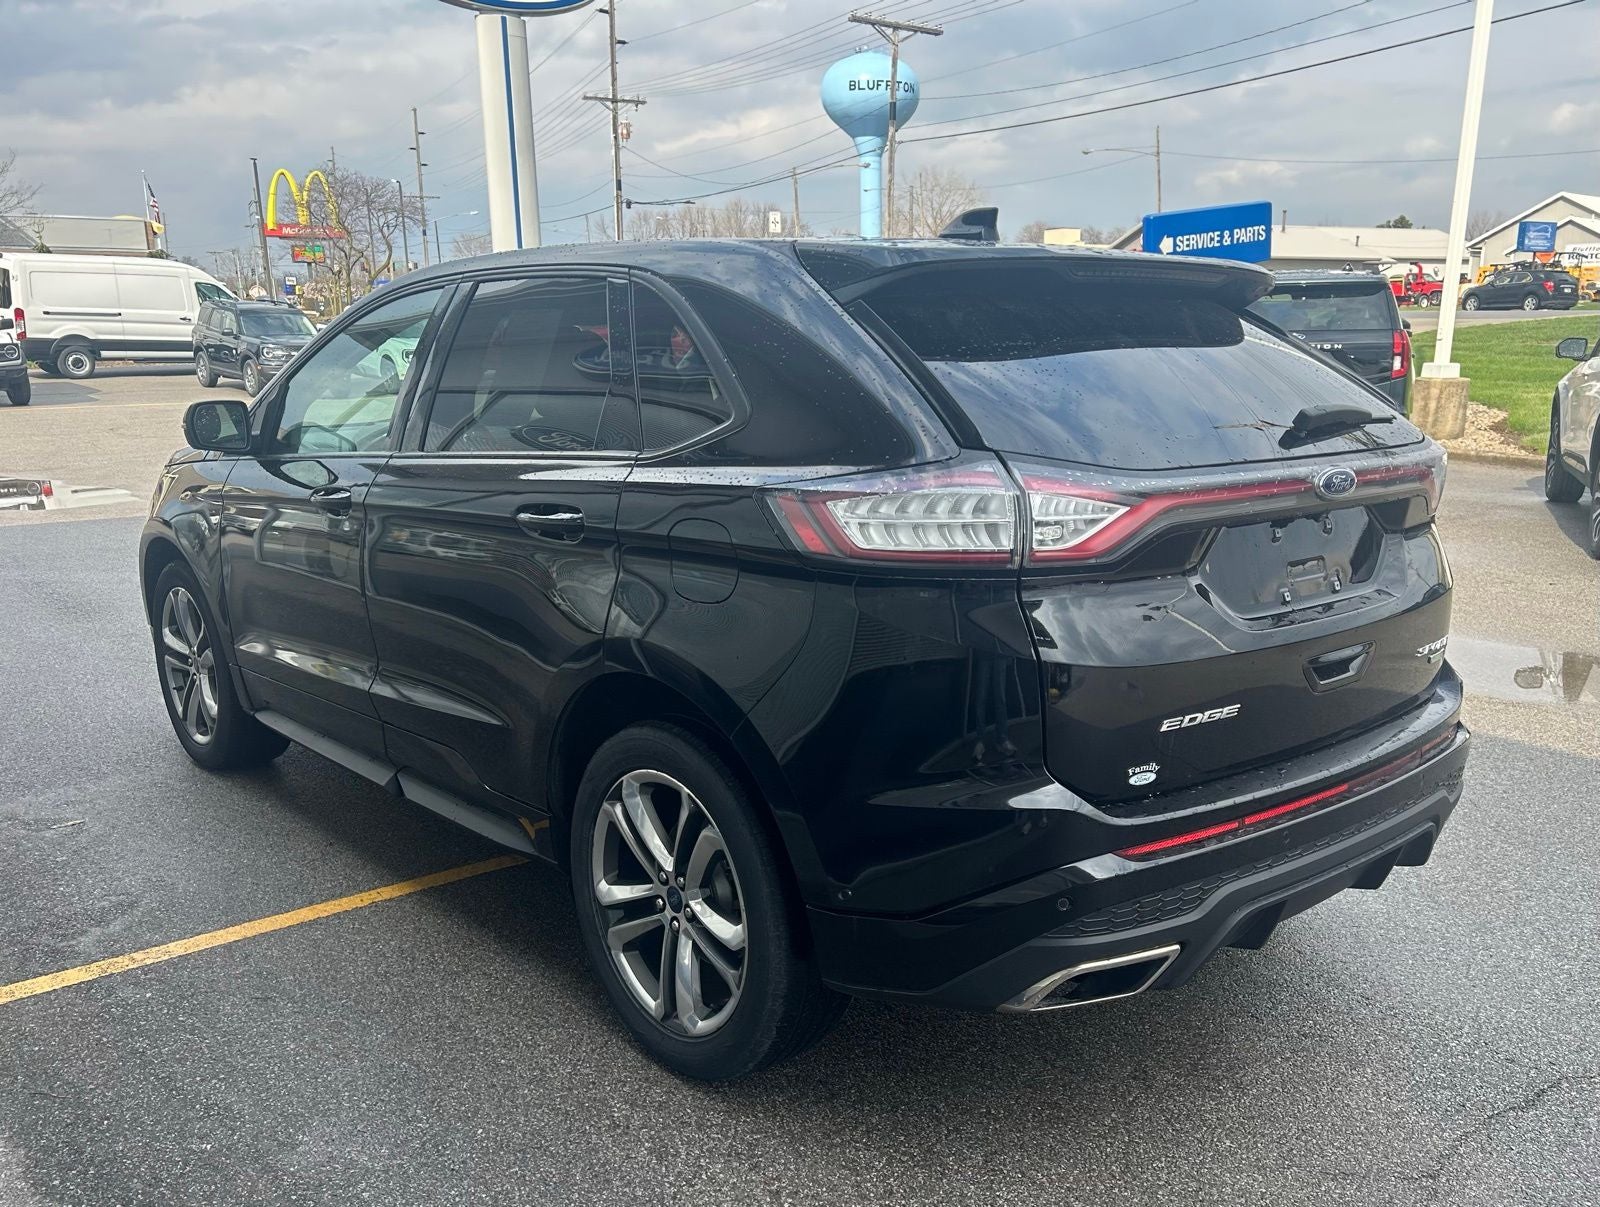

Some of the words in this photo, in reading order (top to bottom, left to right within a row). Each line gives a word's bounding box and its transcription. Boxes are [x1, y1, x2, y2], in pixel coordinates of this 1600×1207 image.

[848, 80, 915, 94] BLUFFTON
[1176, 231, 1221, 252] SERVICE
[1222, 230, 1232, 245] &
[1233, 225, 1266, 244] PARTS
[1160, 704, 1241, 732] EDGE
[1128, 763, 1160, 776] Family
[1134, 773, 1152, 783] Ford
